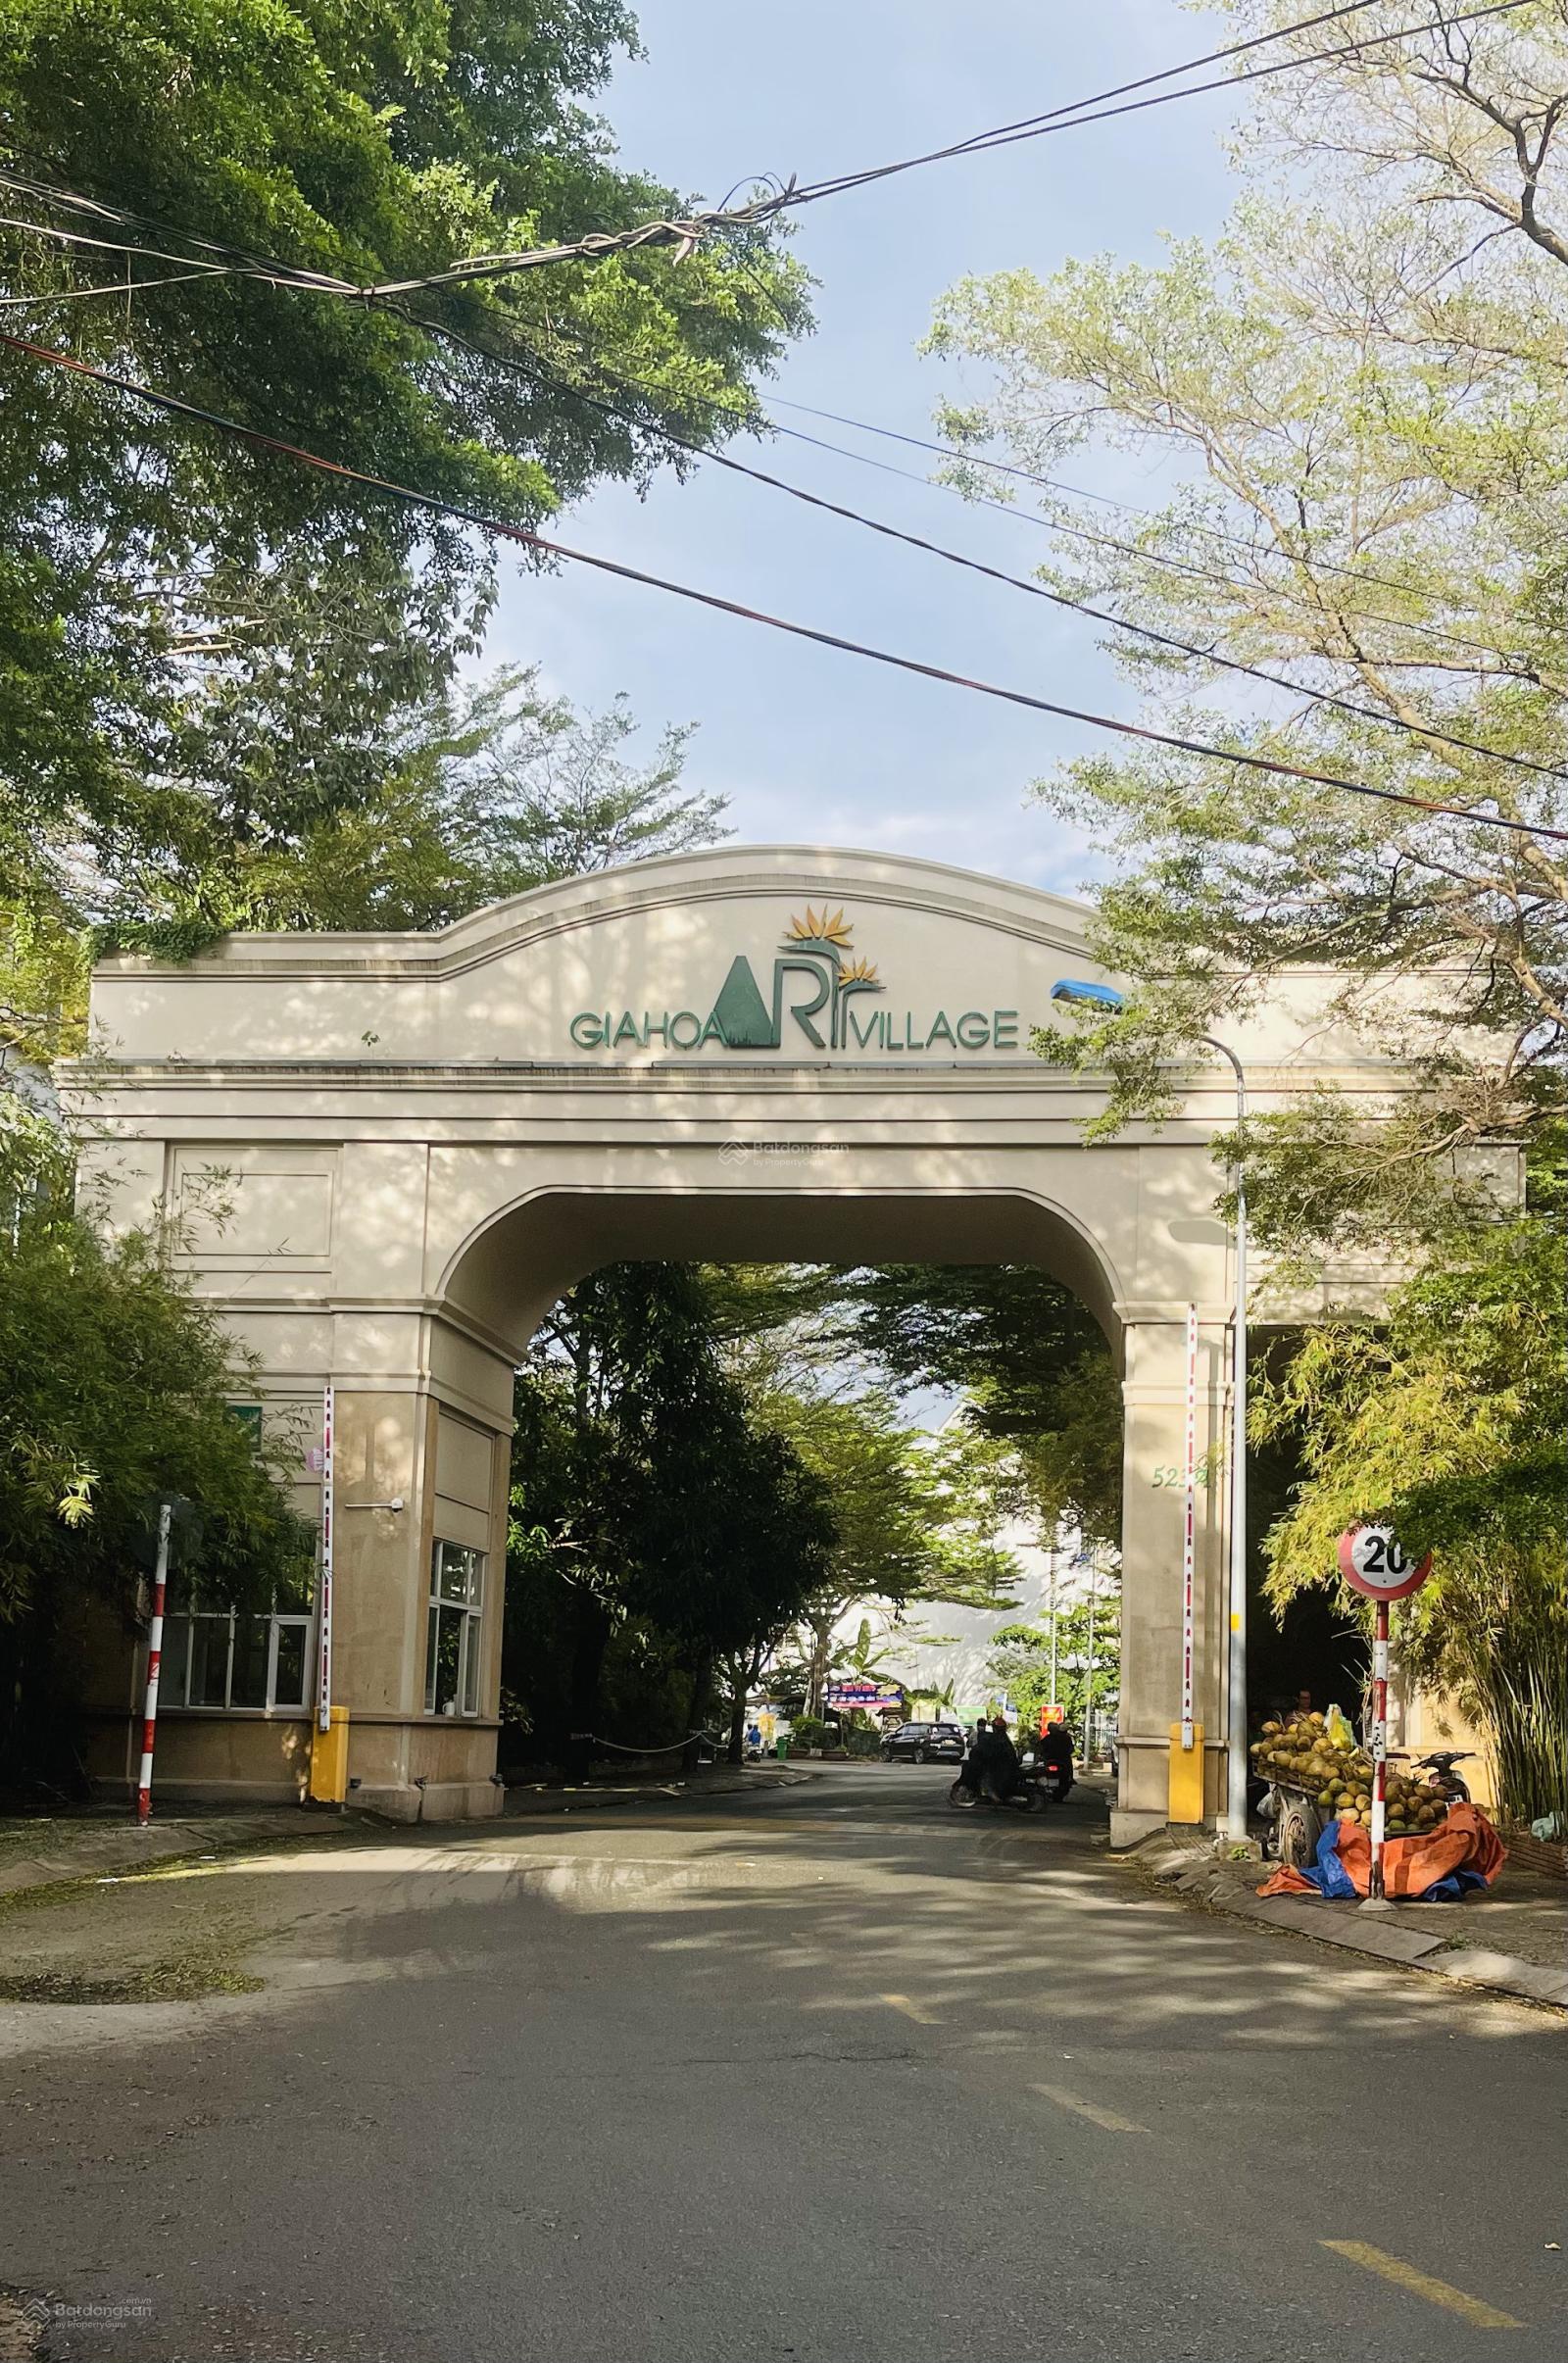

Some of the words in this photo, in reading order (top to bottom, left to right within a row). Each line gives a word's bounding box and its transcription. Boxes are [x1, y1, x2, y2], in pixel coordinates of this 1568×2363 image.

[569, 1010, 729, 1050] GIAHOA
[849, 1009, 1019, 1049] VILLAGE
[1363, 1535, 1408, 1574] 20
